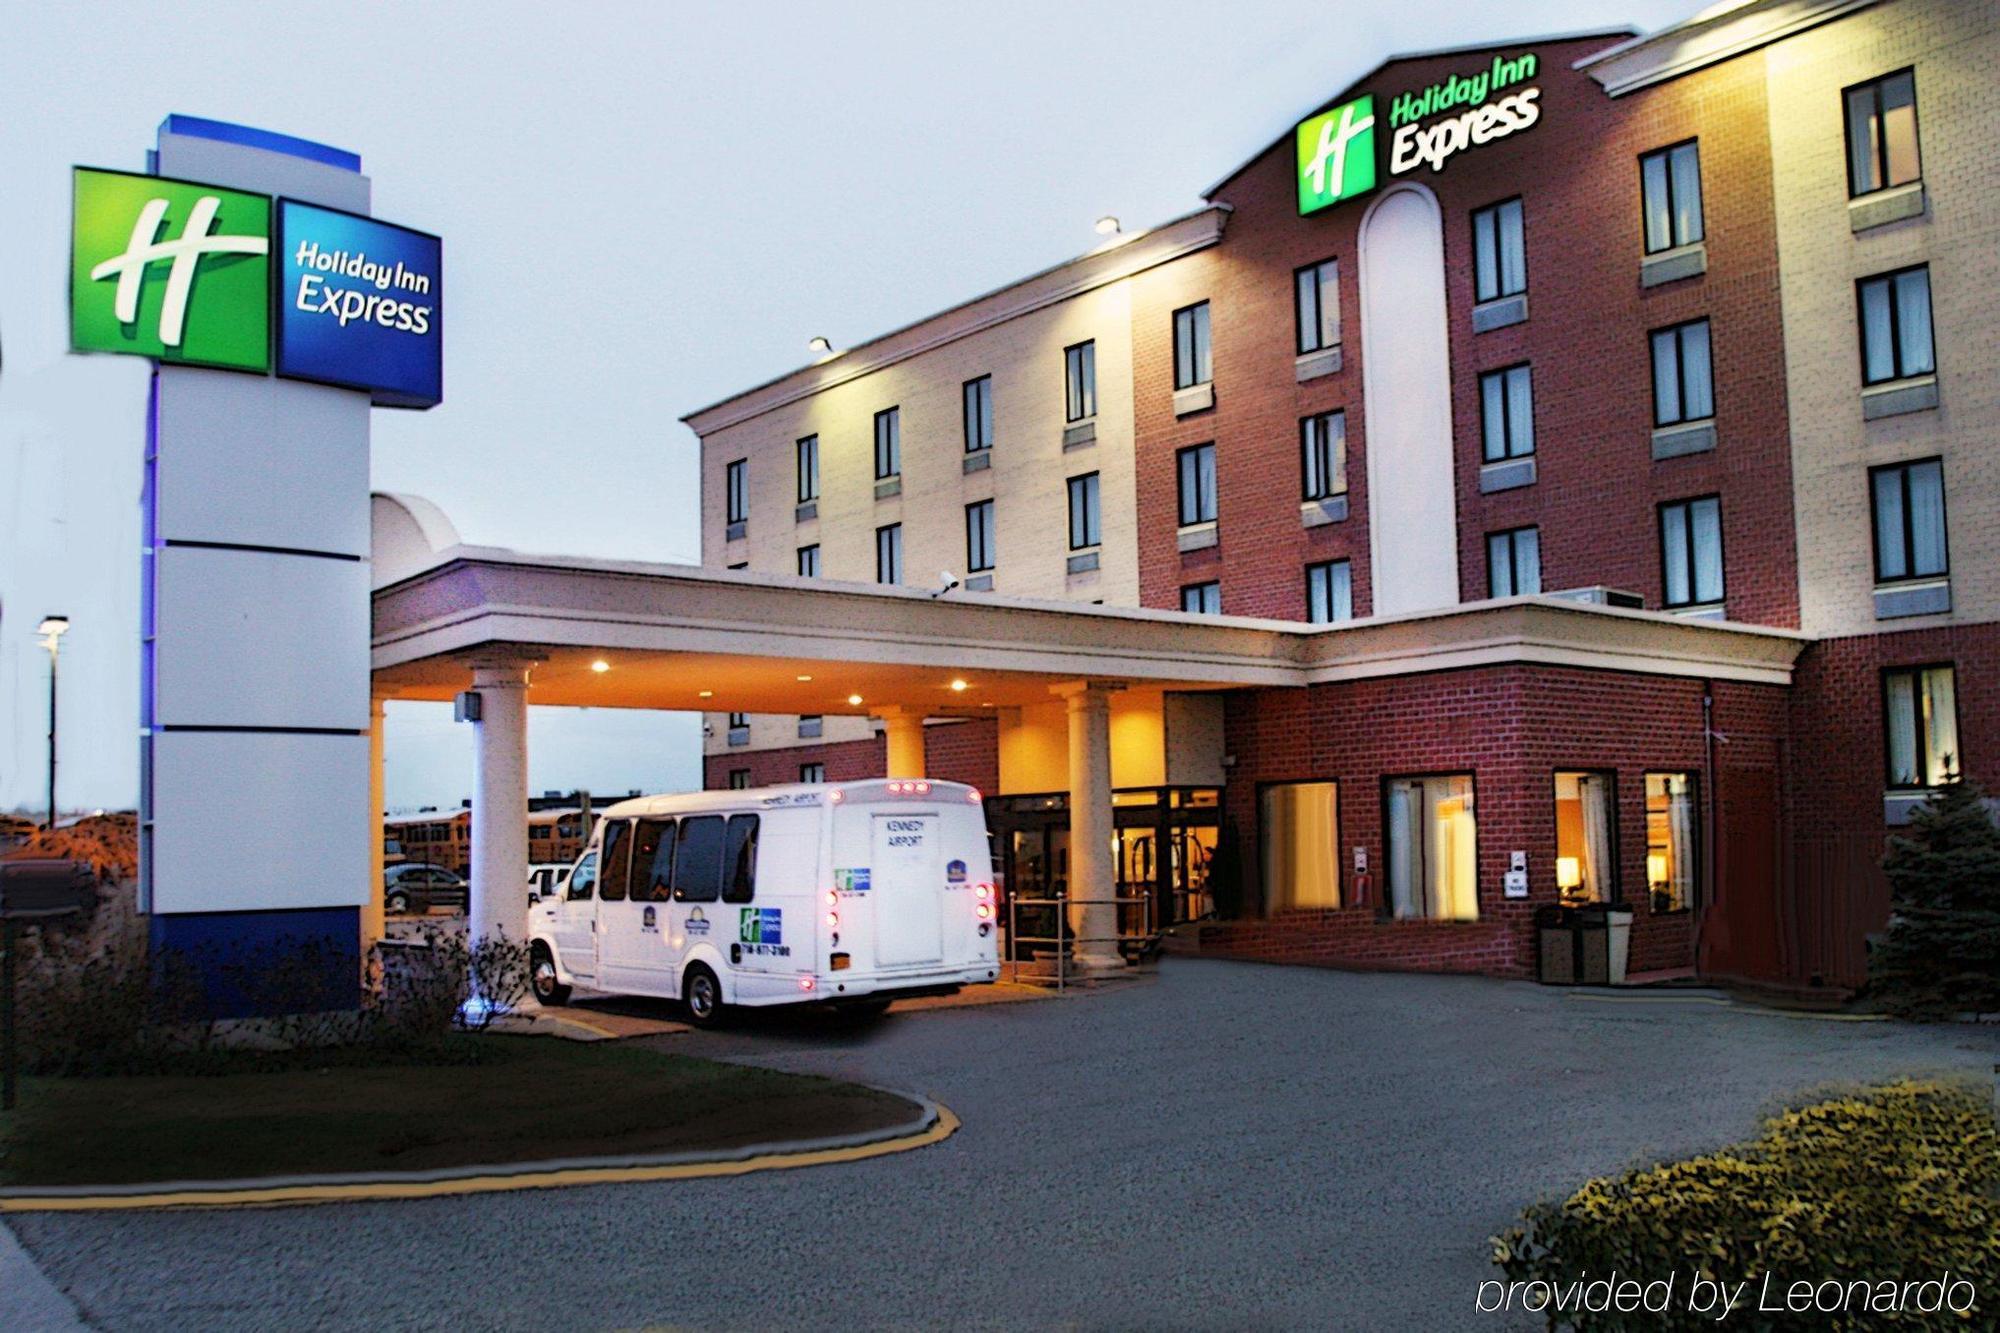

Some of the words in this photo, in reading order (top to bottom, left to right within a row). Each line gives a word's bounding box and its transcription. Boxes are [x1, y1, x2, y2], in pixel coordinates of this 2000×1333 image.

[1389, 72, 1489, 128] Holiday
[1492, 53, 1536, 90] Inn
[1390, 87, 1540, 175] Express
[296, 240, 392, 291] Holiday
[394, 261, 429, 295] Inn
[296, 274, 429, 334] Express
[887, 820, 924, 832] KENNEDY
[888, 835, 922, 847] AIRPORT
